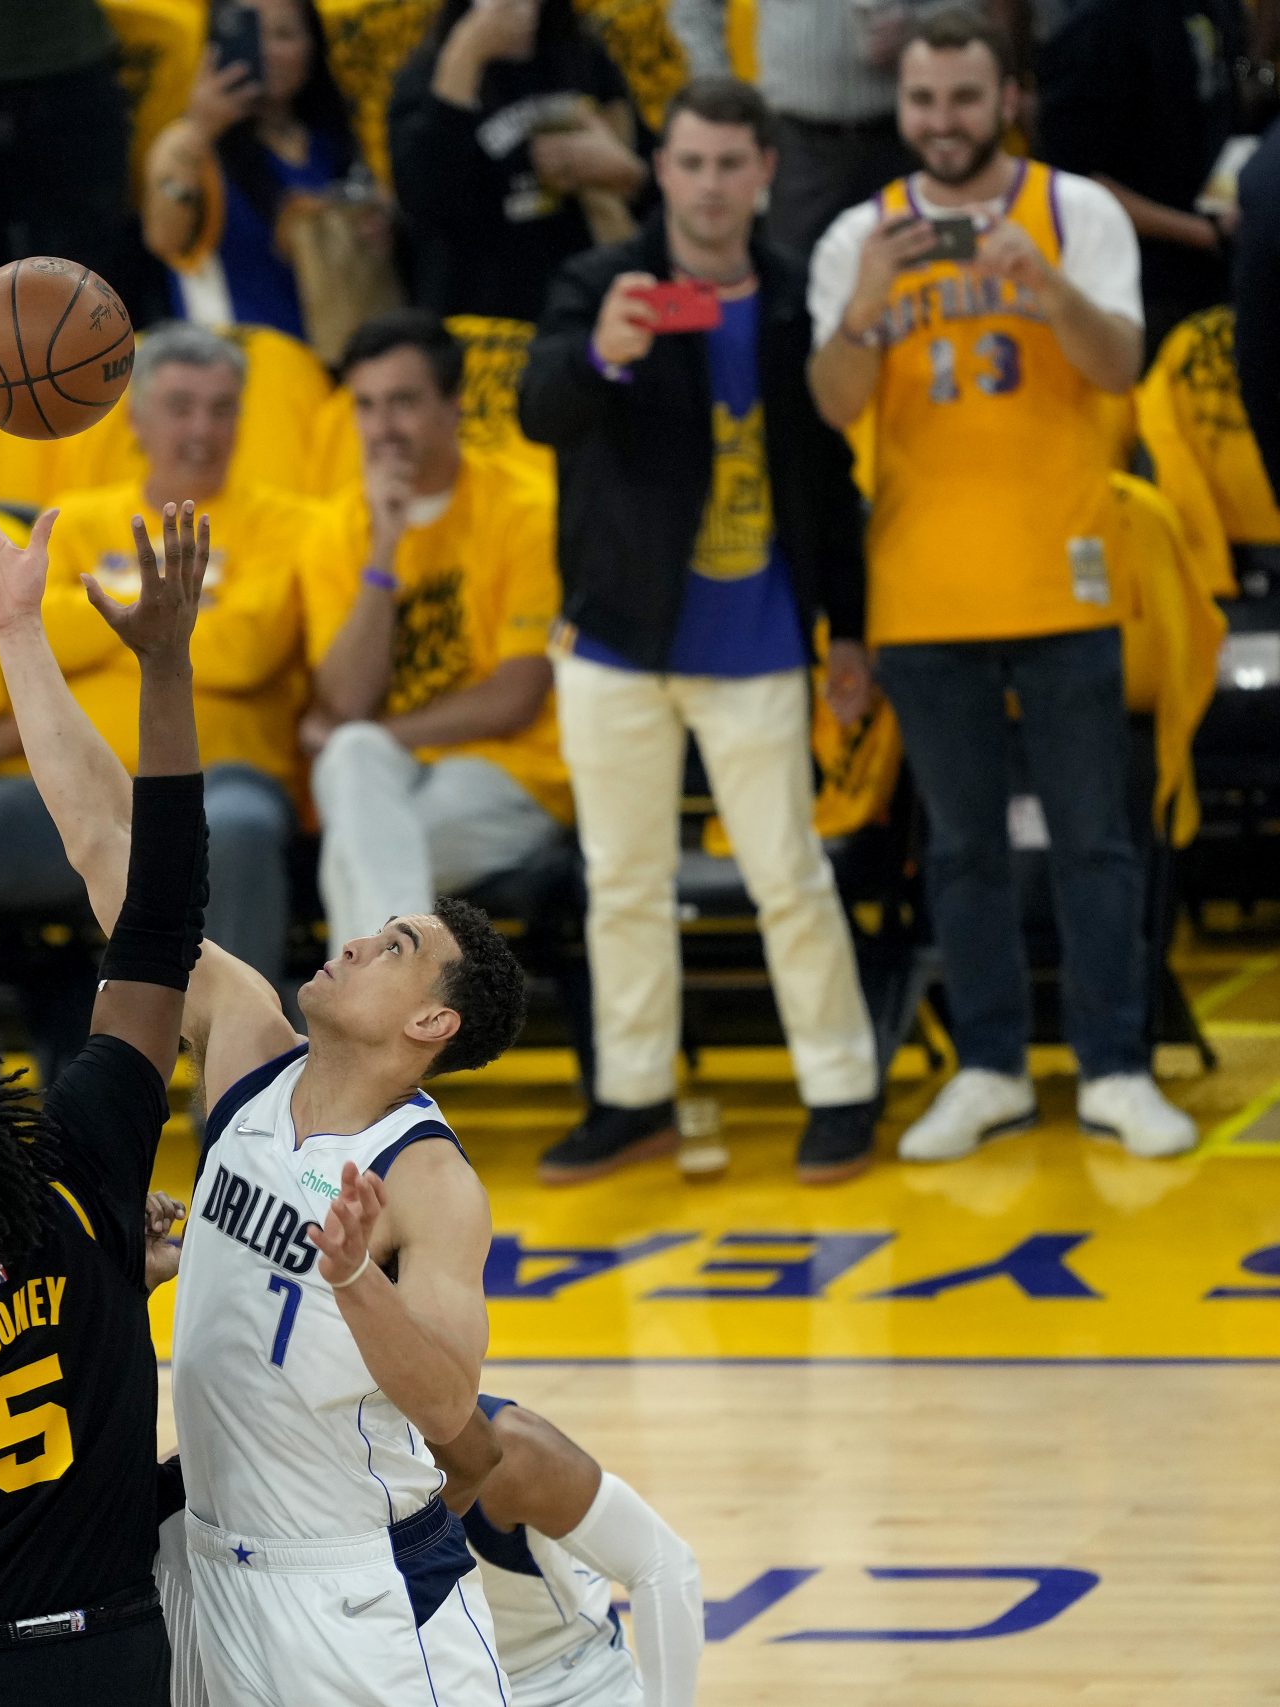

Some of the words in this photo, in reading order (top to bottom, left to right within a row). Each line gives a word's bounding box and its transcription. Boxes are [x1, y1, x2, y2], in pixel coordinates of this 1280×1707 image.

[930, 332, 1022, 405] 13
[200, 1160, 325, 1276] DALLAS
[300, 1168, 342, 1200] chime
[483, 1231, 1105, 1300] YEA
[267, 1272, 304, 1369] 7
